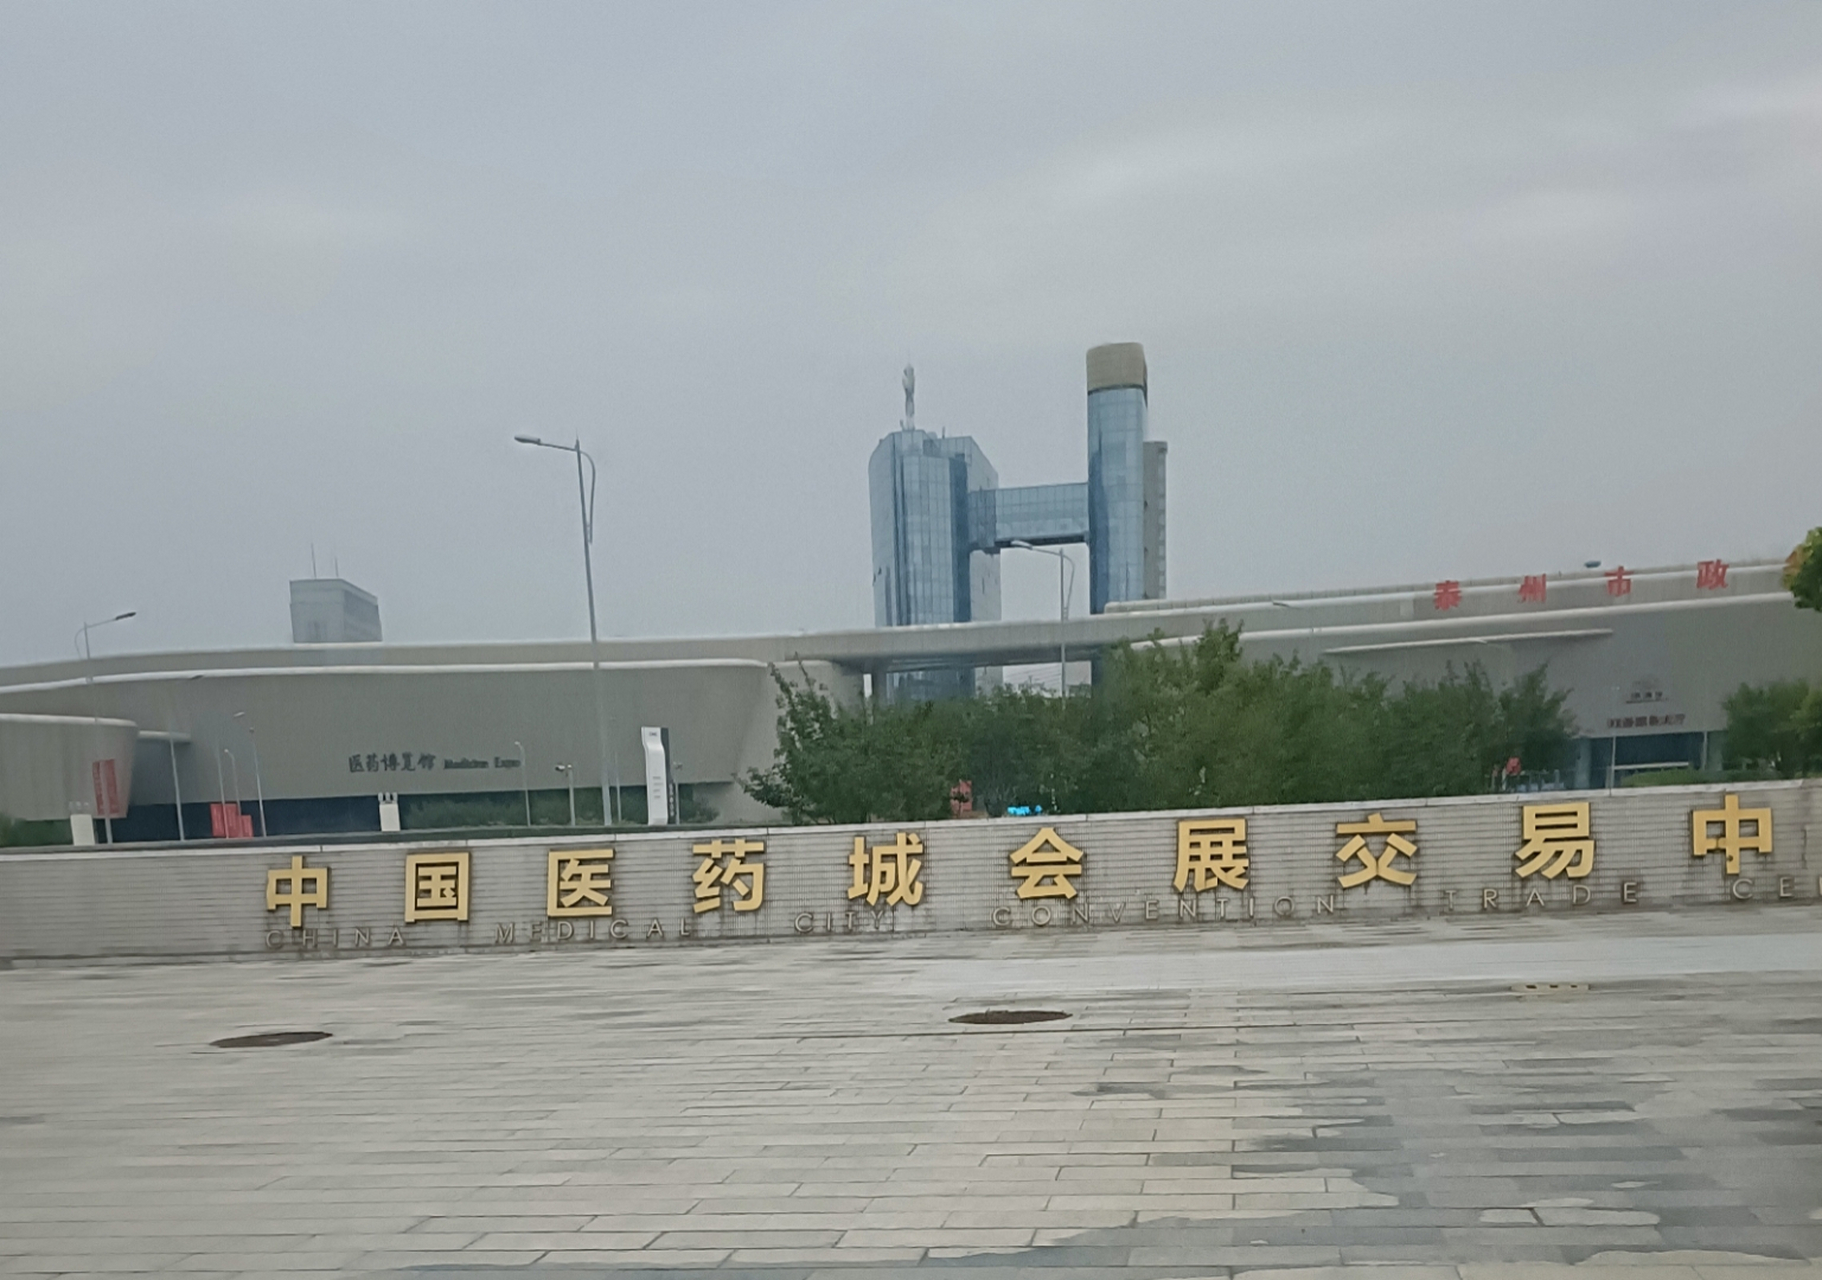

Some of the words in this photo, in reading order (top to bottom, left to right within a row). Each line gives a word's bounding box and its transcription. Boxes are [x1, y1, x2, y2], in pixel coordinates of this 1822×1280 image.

[1434, 559, 1729, 611] 泰州市政
[349, 752, 436, 772] 医药博览馆
[266, 792, 1773, 928] 中国医药城会展交易中
[265, 928, 406, 949] CHINA
[494, 917, 692, 944] MEDICAL
[794, 910, 885, 933] CITY
[991, 894, 1336, 927] CONVENTION
[1444, 881, 1639, 910] TRADE
[1732, 876, 1822, 900] CE
